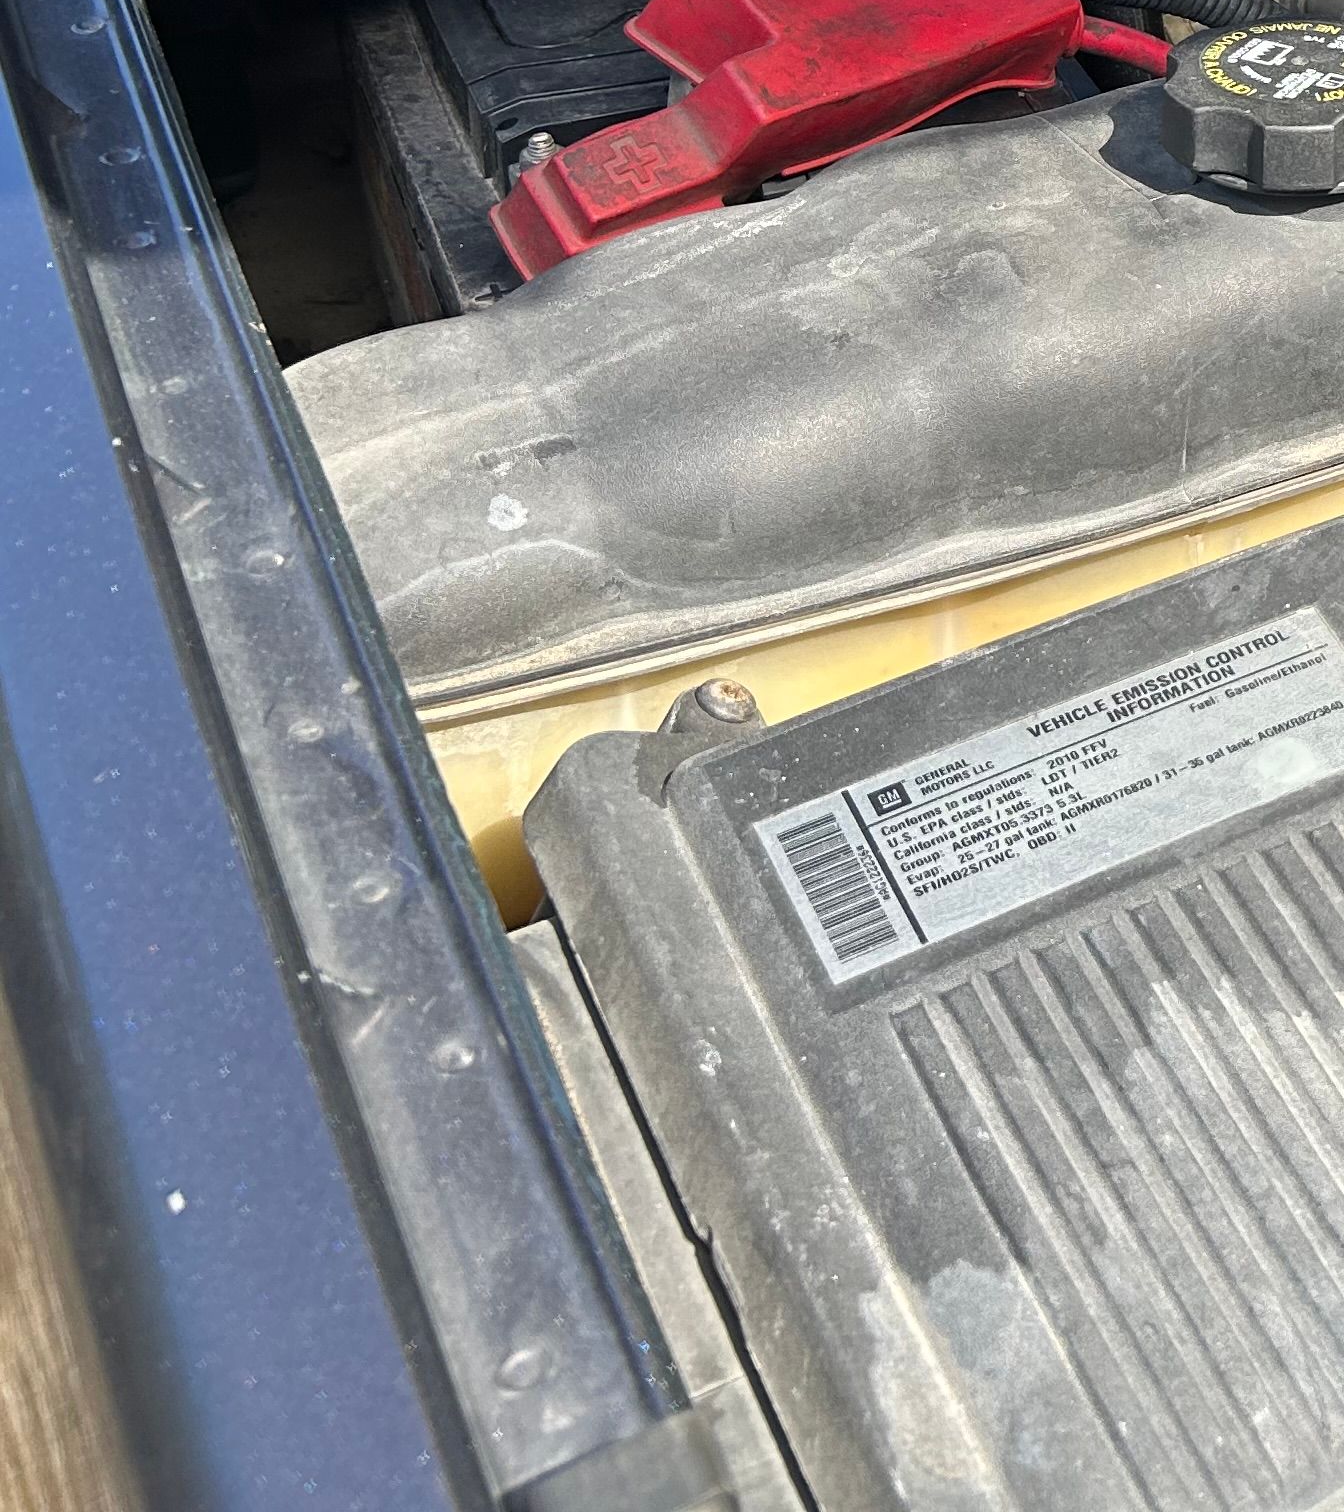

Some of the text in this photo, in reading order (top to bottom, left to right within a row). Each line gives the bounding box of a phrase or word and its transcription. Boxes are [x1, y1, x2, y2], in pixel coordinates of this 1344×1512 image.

[1250, 23, 1313, 35] JAMAIS
[1312, 23, 1342, 35] NE
[1026, 627, 1290, 739] VEHICLE EMISSION CONTROL
[1105, 663, 1236, 723] INFORMATION
[1188, 651, 1327, 713] Fuel: Gasoline/Ethanol
[876, 788, 900, 805] GM
[879, 738, 1109, 837] Conforms to regulations: 2010 FFV
[886, 829, 917, 848] U.S.
[919, 817, 948, 835] EPA
[949, 802, 984, 823] class
[994, 785, 1027, 805] stds:
[1040, 768, 1069, 785] LDT
[1081, 747, 1121, 769] TIER2
[913, 757, 970, 786] GENERAL
[919, 760, 995, 796] MOTORS LLC
[892, 828, 957, 861] California
[958, 813, 993, 834] class
[1003, 795, 1036, 816] stds:
[1047, 780, 1074, 797] N/A
[899, 847, 946, 874] Group:
[1055, 789, 1087, 809] 5.3L
[906, 863, 944, 886] Evap:
[1002, 829, 1026, 846] gal
[1204, 747, 1226, 763] gal
[1026, 829, 1062, 850] OBD:
